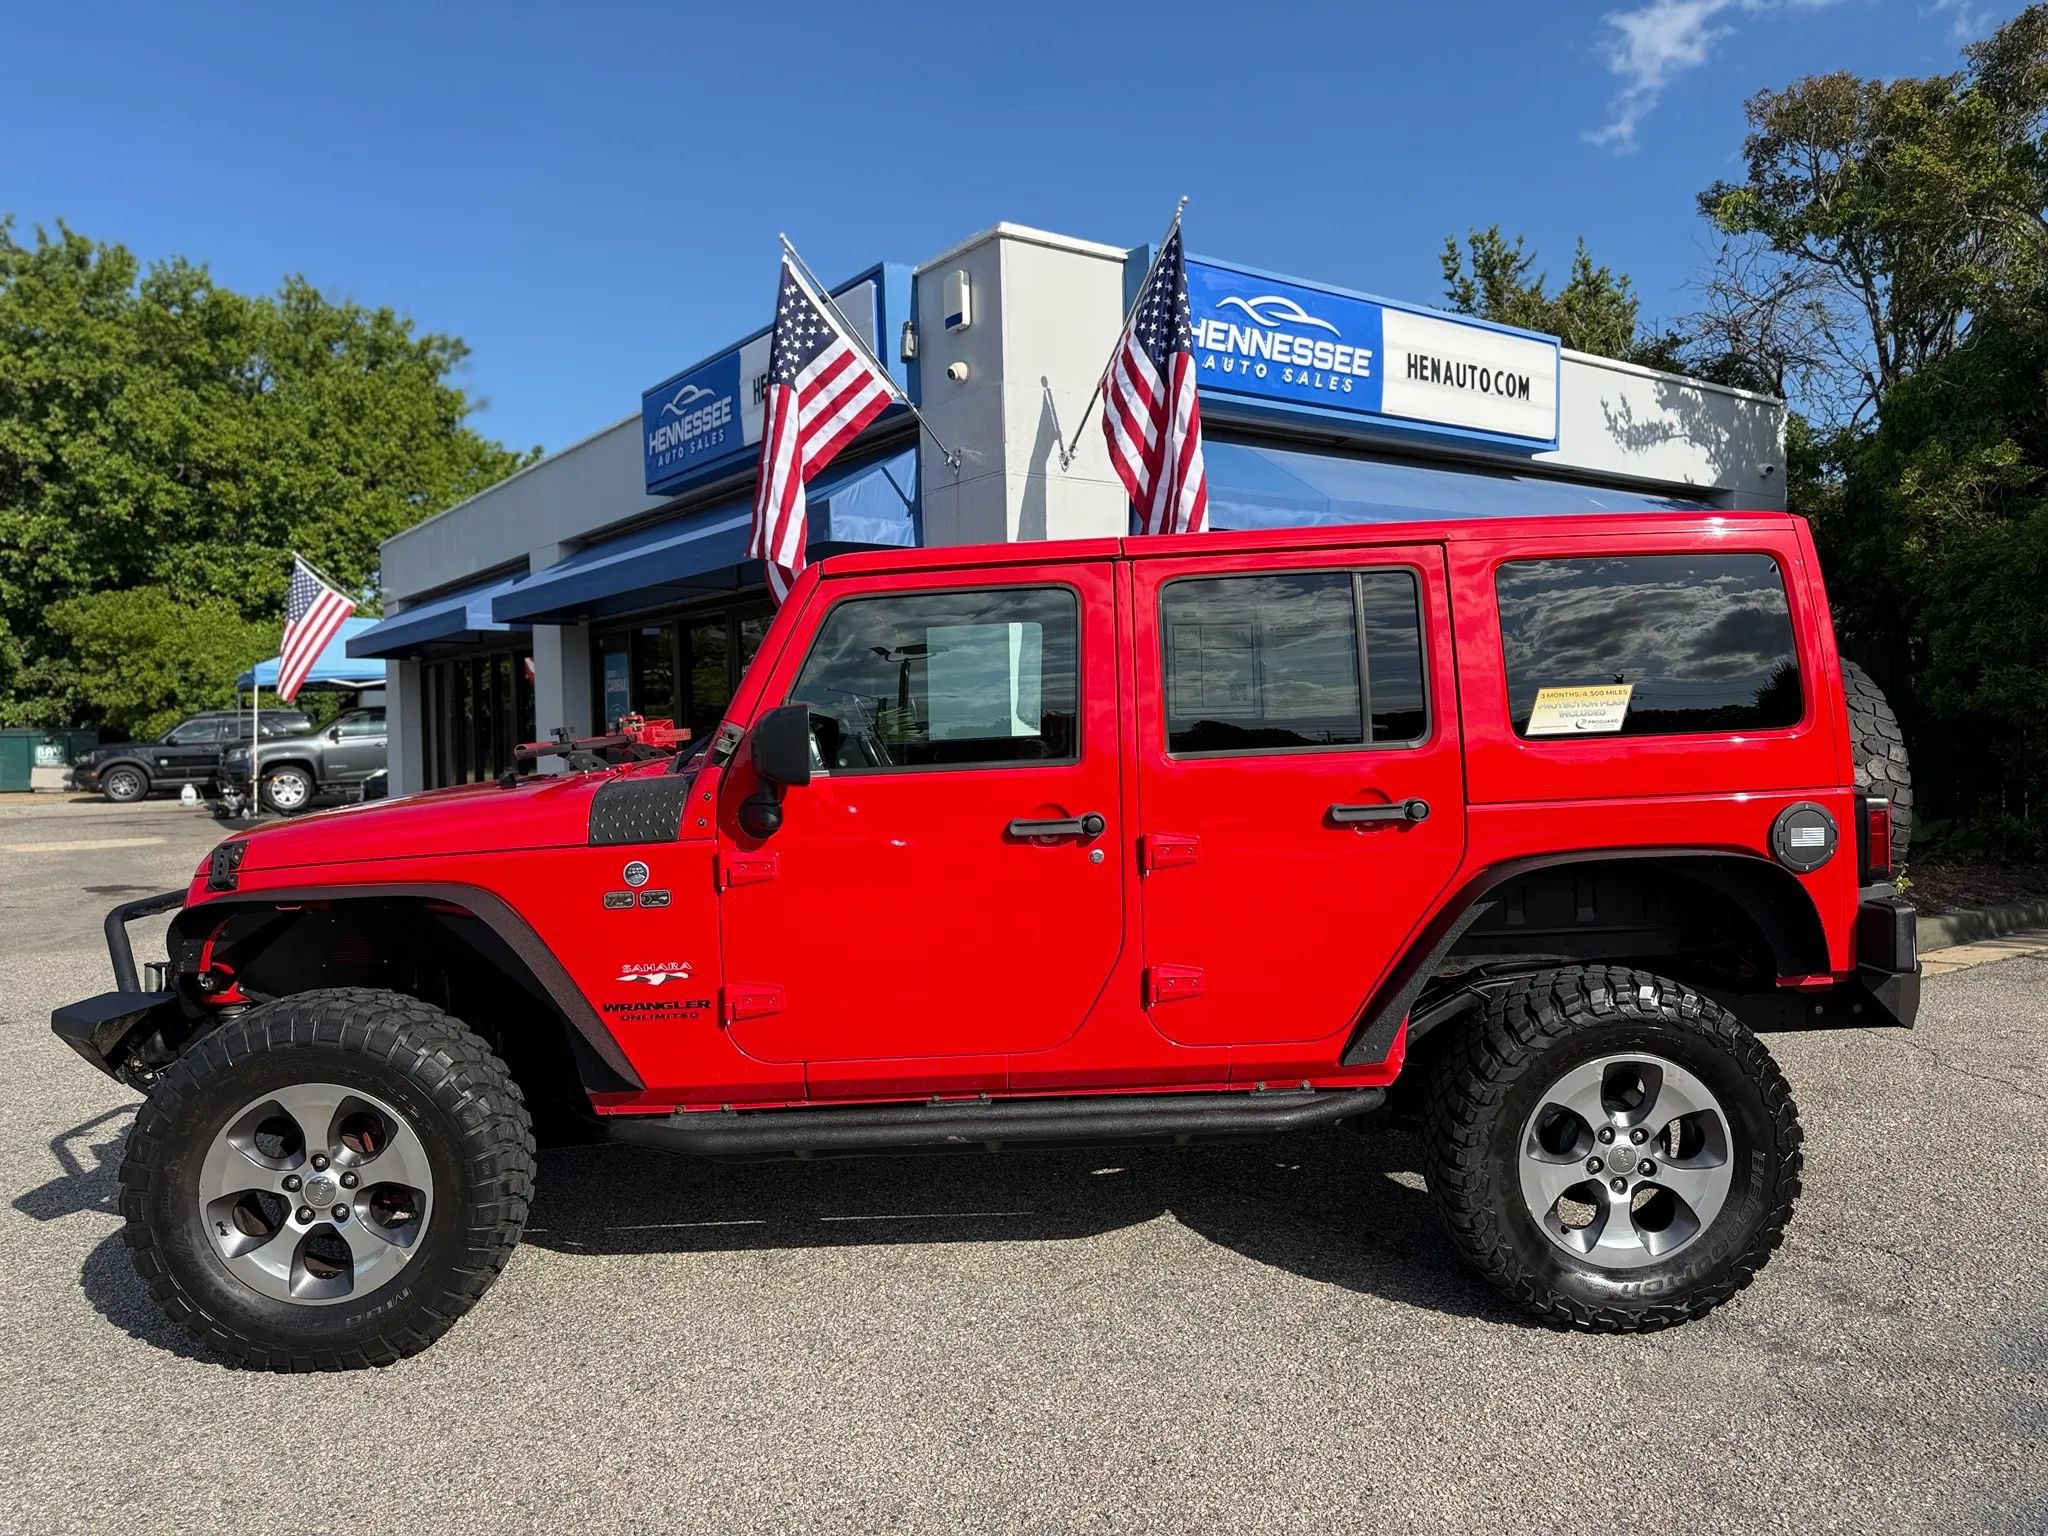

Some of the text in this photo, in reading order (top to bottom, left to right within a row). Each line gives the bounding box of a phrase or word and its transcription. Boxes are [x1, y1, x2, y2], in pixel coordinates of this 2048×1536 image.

[1191, 317, 1373, 378] HENNESSEE
[1202, 354, 1354, 393] AUTO SALES
[648, 395, 732, 457] HENNESSEE
[657, 428, 725, 468] AUTO SALES
[1558, 709, 1607, 718] INCLUDED
[621, 961, 693, 974] SAHARA
[602, 999, 711, 1013] WRANGLER
[621, 1012, 699, 1022] UNLIMITED
